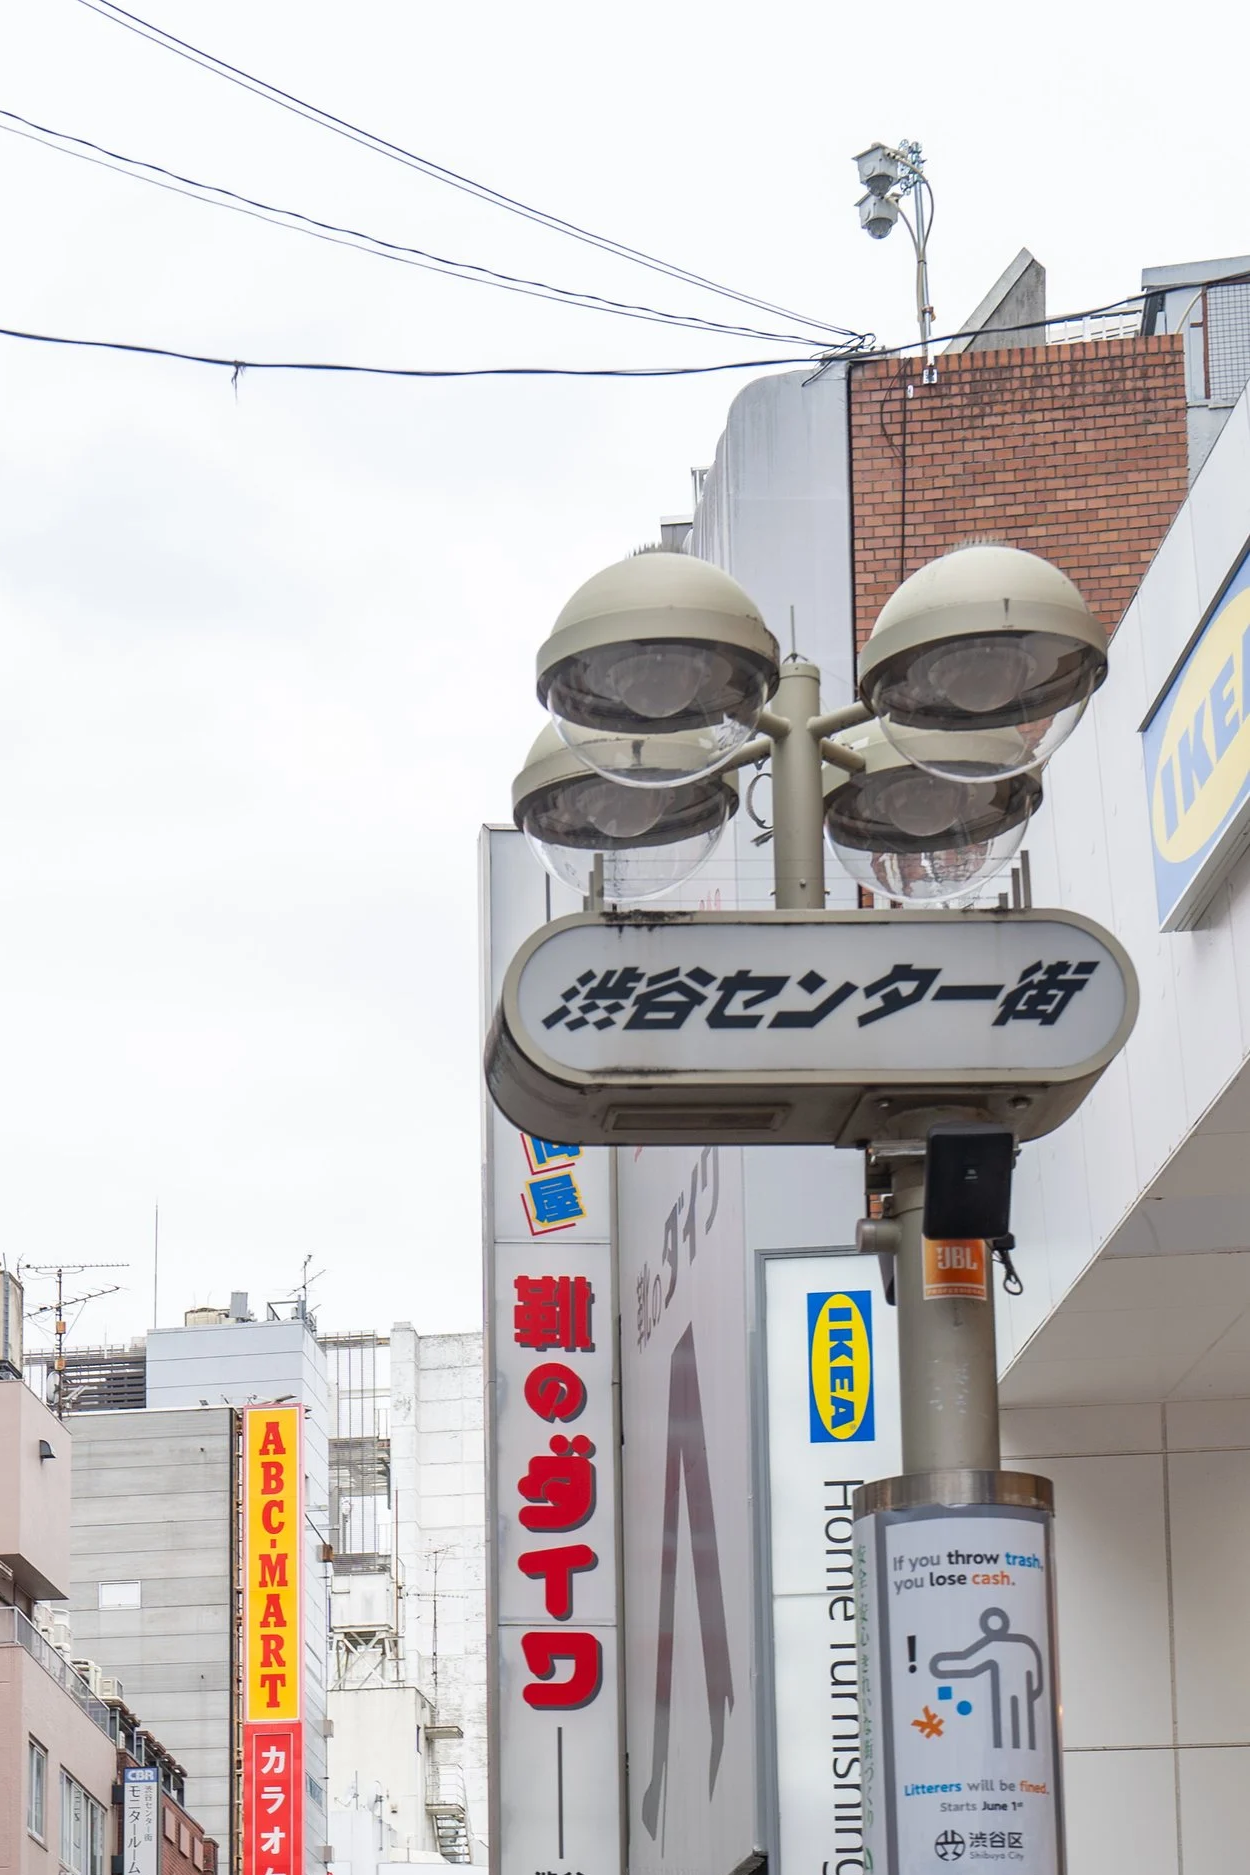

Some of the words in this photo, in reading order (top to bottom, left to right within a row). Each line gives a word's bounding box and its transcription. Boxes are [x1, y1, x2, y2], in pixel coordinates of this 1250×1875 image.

[1160, 622, 1250, 844] IKE
[542, 959, 1100, 1032] 渋谷センター街
[826, 1304, 858, 1431] IKEA
[513, 1274, 603, 1711] 靴のダイワ
[259, 1421, 288, 1709] ABC-MART
[893, 1556, 905, 1572] If
[908, 1555, 941, 1571] you
[947, 1550, 1000, 1567] throw
[1005, 1552, 1044, 1570] trash,
[893, 1577, 925, 1595] you
[929, 1571, 967, 1587] lose
[972, 1571, 1016, 1587] cash.
[904, 1781, 963, 1797] Litterers
[967, 1780, 995, 1793] will
[999, 1780, 1016, 1793] be
[1019, 1781, 1050, 1795] fined.
[940, 1801, 977, 1813] Starts
[981, 1801, 1008, 1813] June
[128, 1785, 142, 1875] モニタールーム
[969, 1831, 1024, 1850] 渋谷区
[969, 1851, 1008, 1862] Shibuya
[1010, 1851, 1024, 1862] City
